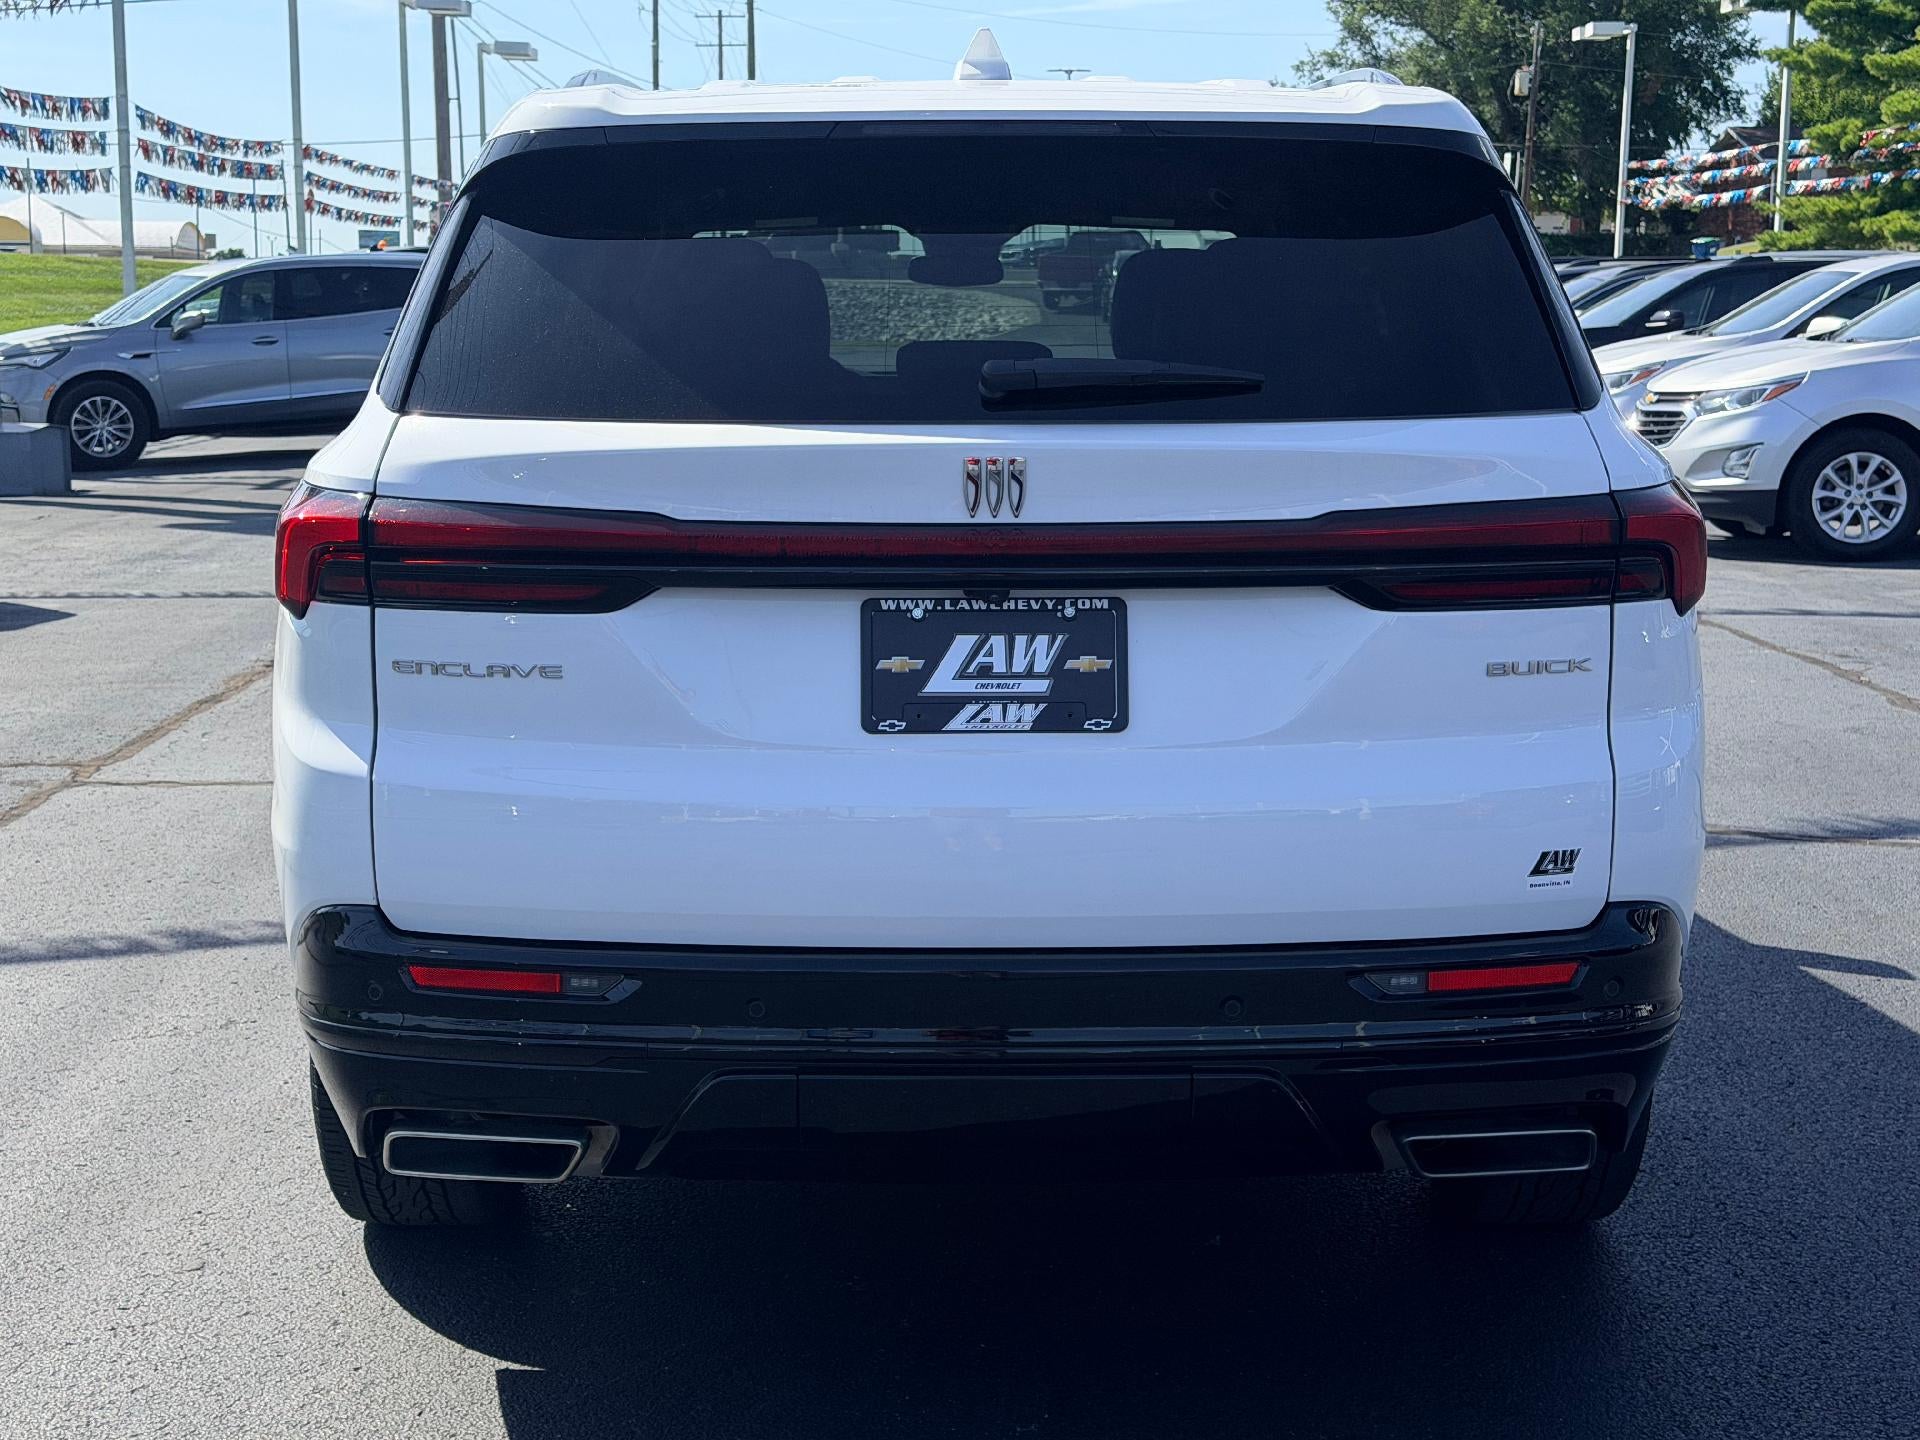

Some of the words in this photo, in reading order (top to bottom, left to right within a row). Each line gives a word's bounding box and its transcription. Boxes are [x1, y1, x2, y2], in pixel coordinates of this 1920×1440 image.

[392, 660, 563, 679] ENCLAVE
[919, 634, 1067, 695] LAW
[1486, 658, 1592, 677] BUICK
[975, 682, 1022, 690] CHEVROLET
[941, 703, 1048, 730] LAW
[1527, 848, 1582, 877] LAW
